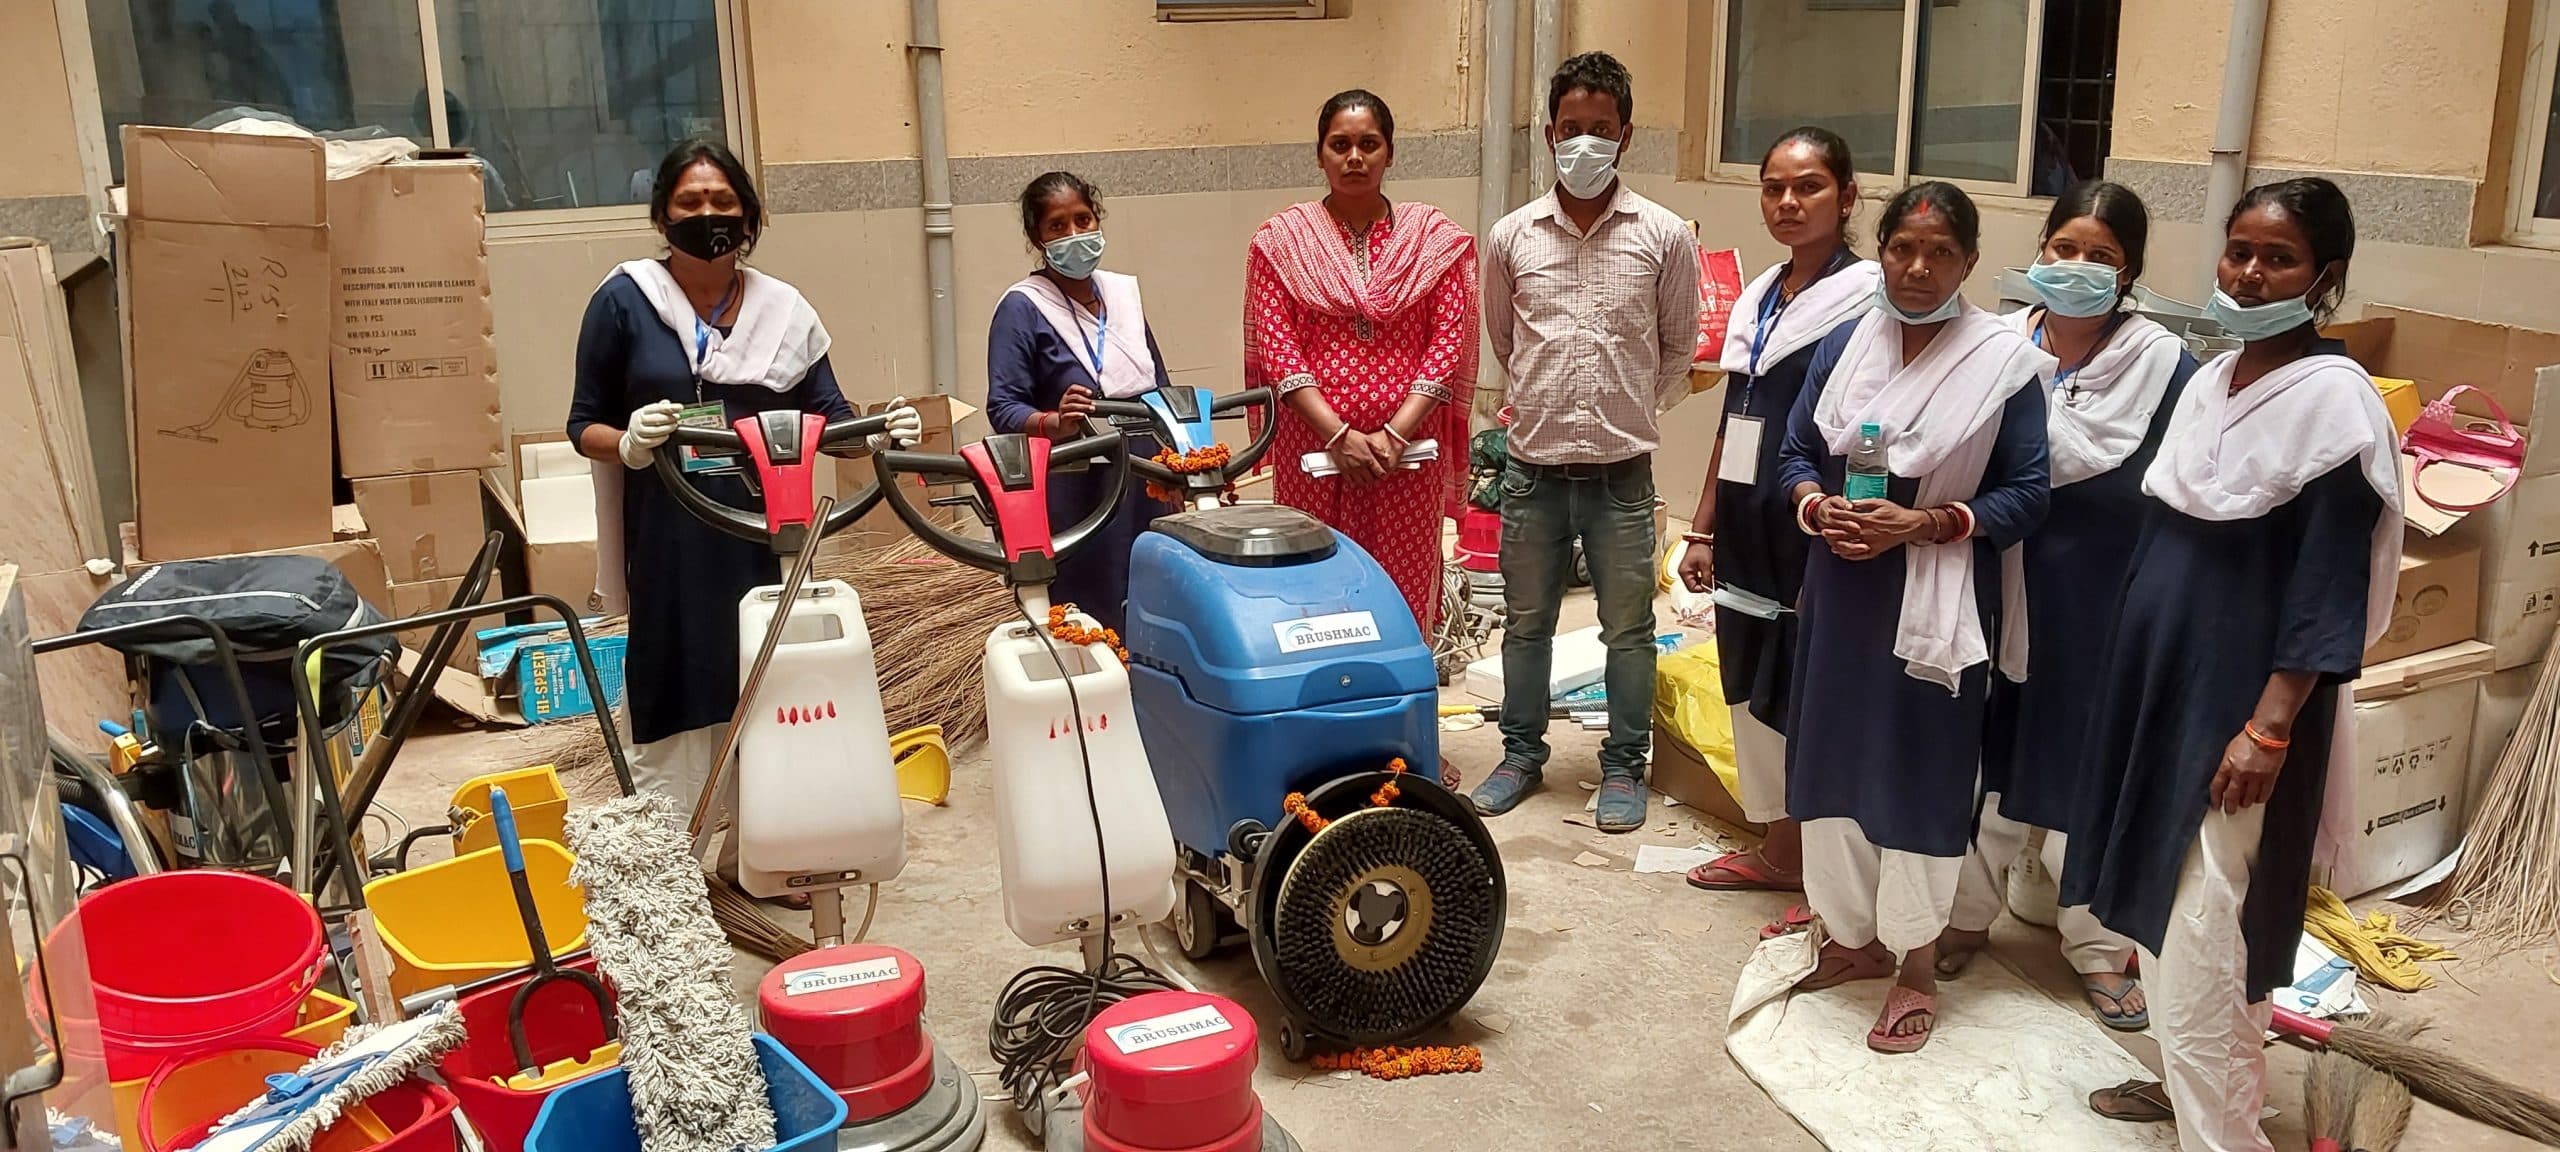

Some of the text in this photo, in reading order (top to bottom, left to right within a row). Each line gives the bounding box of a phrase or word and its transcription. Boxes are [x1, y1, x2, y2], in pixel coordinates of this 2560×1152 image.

[341, 267, 357, 275] ITEM
[416, 280, 443, 289] VACUUM
[444, 279, 476, 288] CLEANERS
[344, 299, 361, 307] WITH
[362, 299, 379, 307] ITALY
[380, 298, 402, 306] MOTOR
[371, 314, 384, 322] PCS
[1295, 625, 1372, 646] BRUSHMAC
[532, 651, 550, 715] HI-SPEED
[801, 966, 899, 990] BRUSHMAC
[1131, 1015, 1227, 1045] BRUSHMAC
